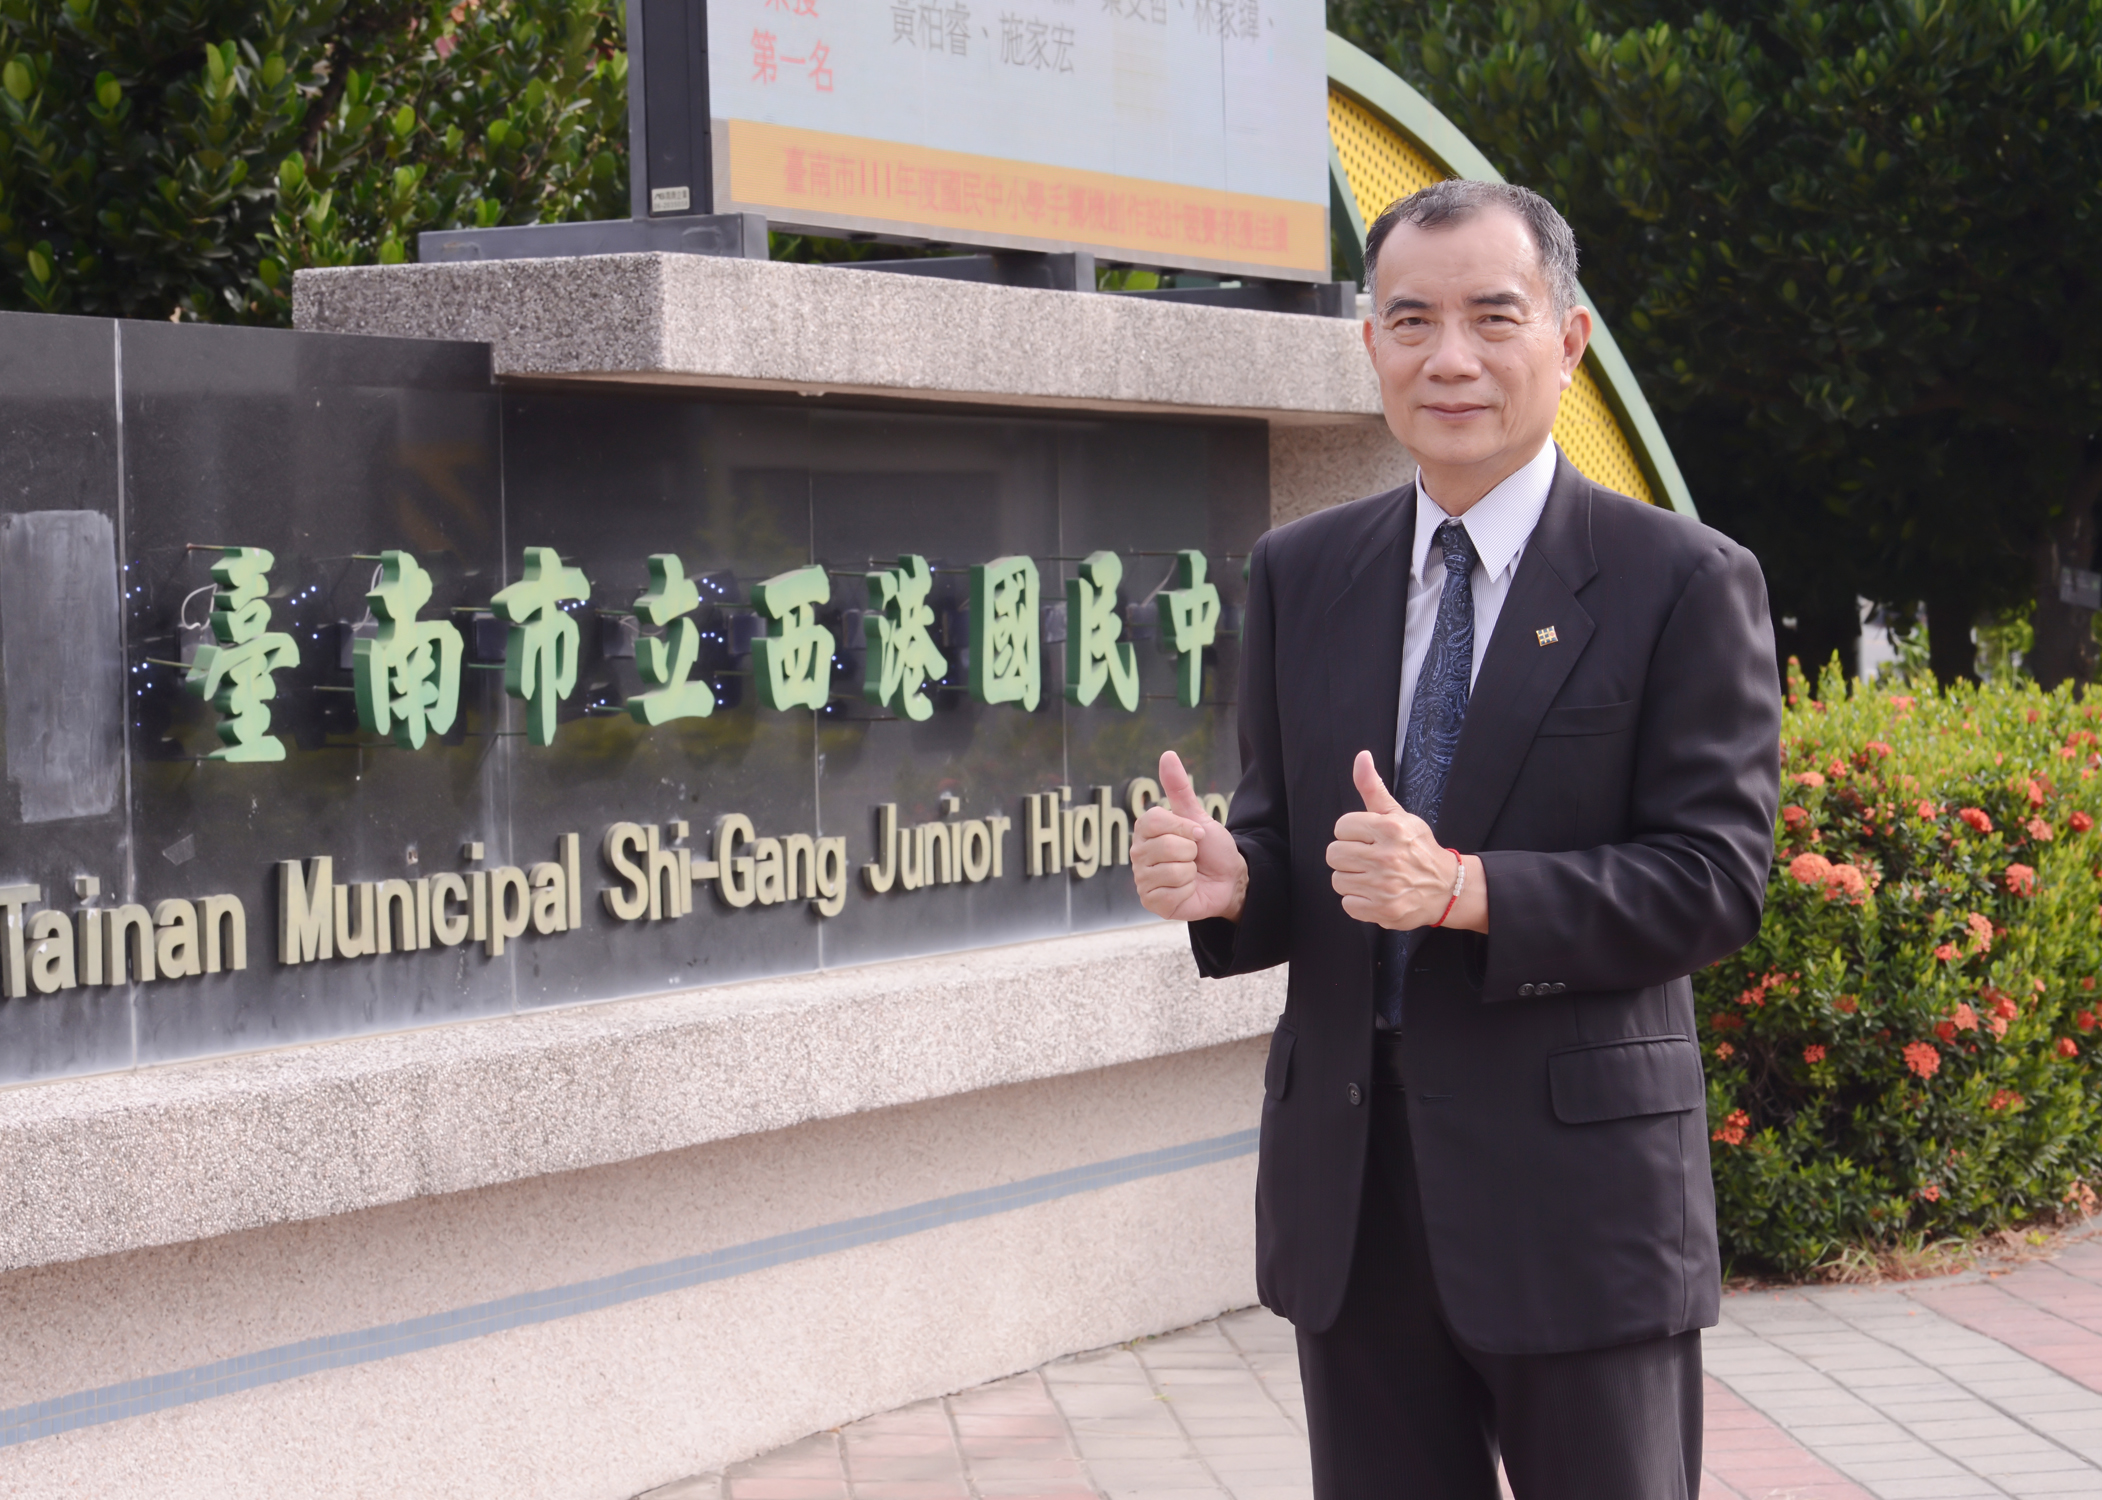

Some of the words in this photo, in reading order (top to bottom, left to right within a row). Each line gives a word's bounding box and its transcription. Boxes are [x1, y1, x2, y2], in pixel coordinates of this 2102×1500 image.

[750, 28, 834, 92] 第一名
[186, 546, 1252, 763] 臺南市立西港國民中
[0, 875, 247, 998] Tainan
[278, 832, 581, 965] Municipal
[602, 812, 847, 920] Shi-Gang
[862, 795, 1011, 893] Junior
[1024, 785, 1129, 879] High
